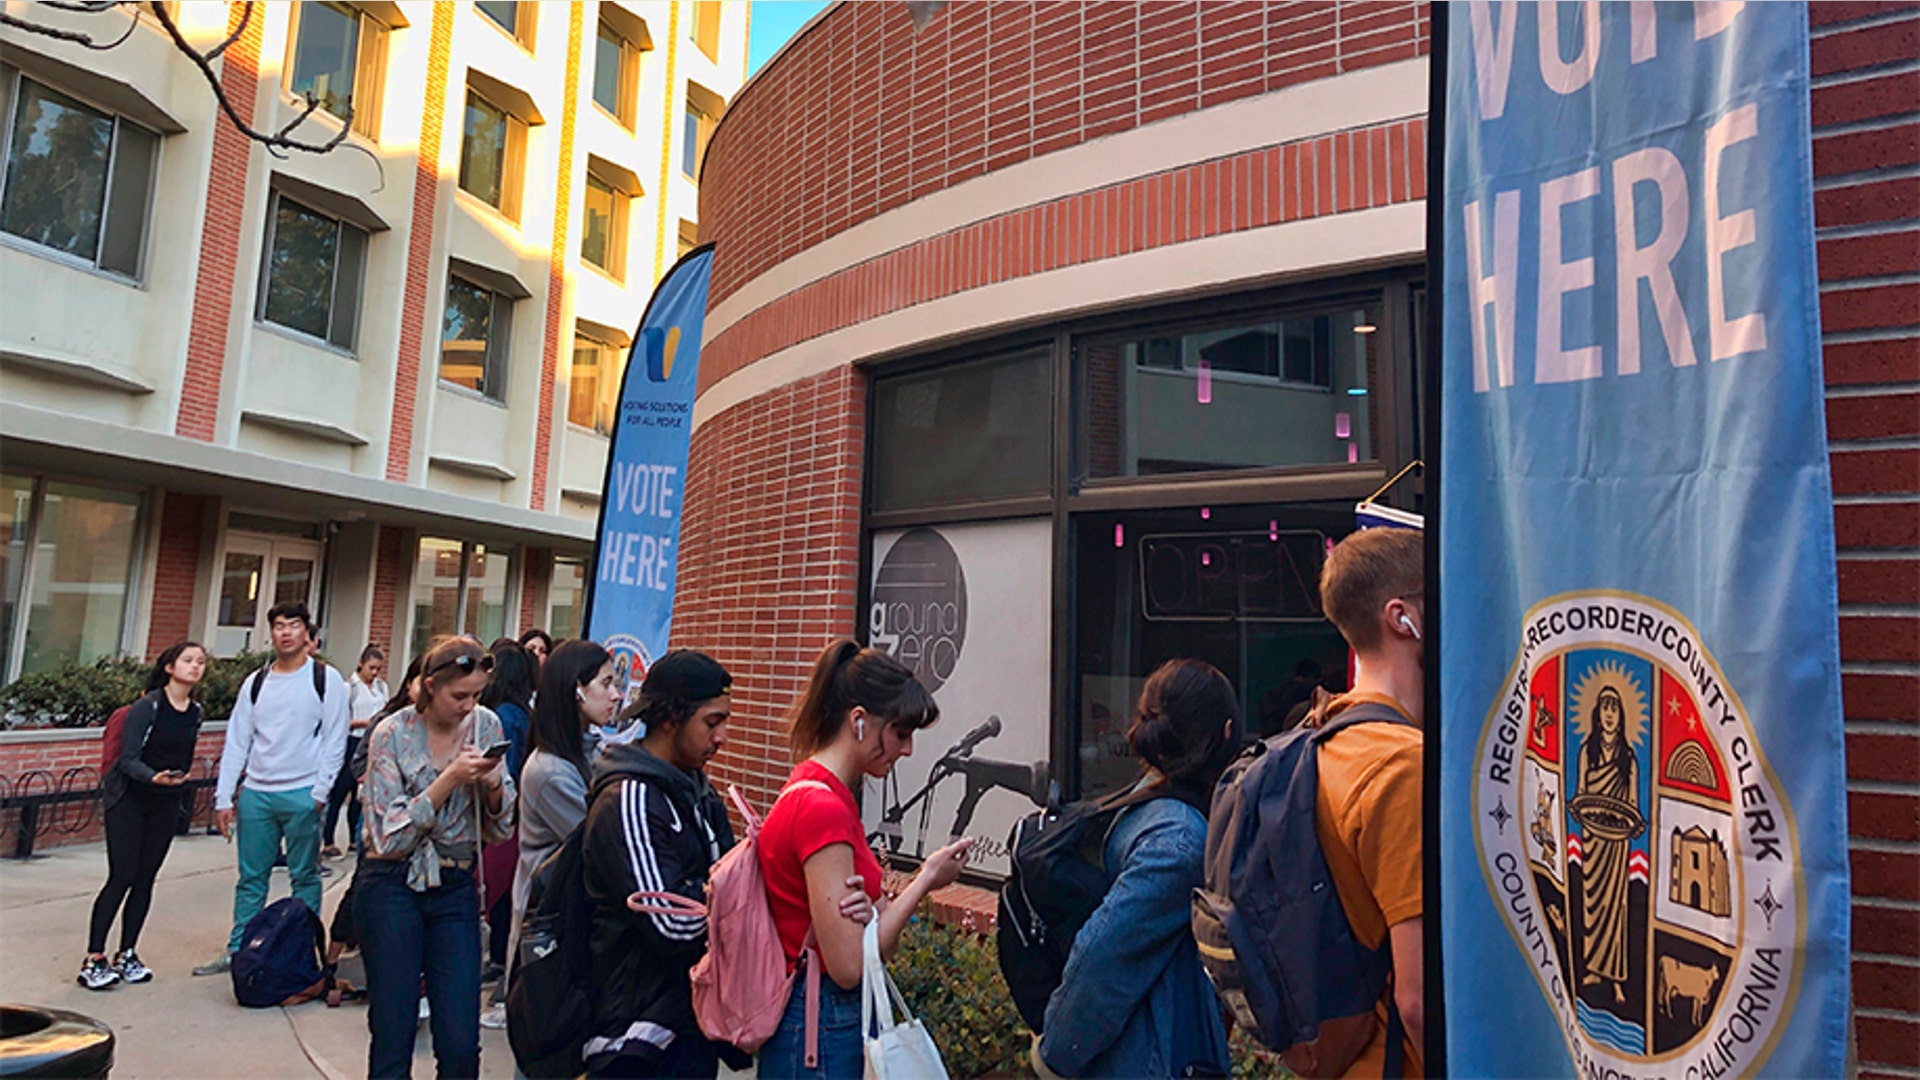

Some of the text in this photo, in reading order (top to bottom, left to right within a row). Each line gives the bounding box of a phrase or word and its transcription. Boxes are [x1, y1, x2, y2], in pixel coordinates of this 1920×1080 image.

[1464, 102, 1768, 393] HERE
[617, 461, 677, 518] VOTE
[602, 531, 671, 591] HERE
[1147, 542, 1319, 613] OPEN
[1731, 737, 1783, 862] CLERK
[1495, 852, 1553, 968] COUNTY
